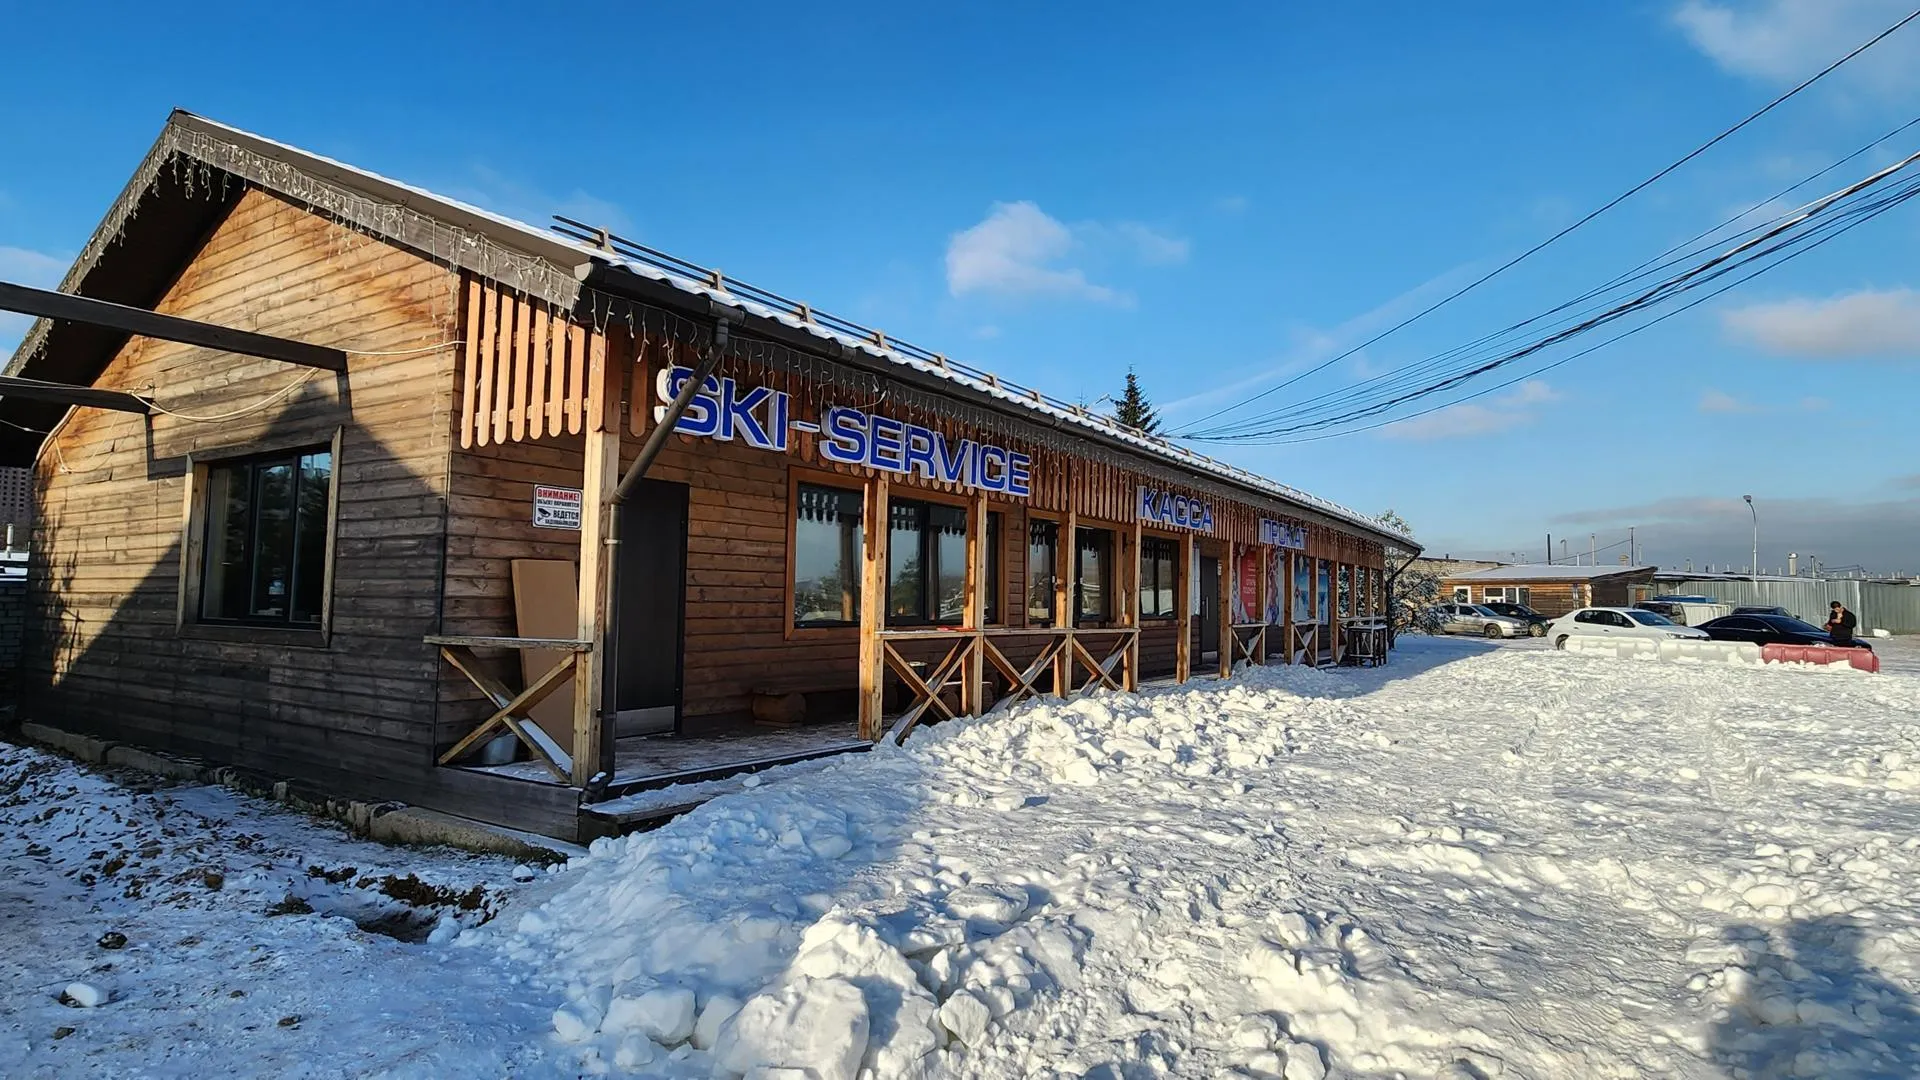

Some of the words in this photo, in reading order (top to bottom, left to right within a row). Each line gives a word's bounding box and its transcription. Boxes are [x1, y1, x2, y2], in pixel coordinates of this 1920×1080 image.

[657, 366, 1030, 497] SKI-SERVICE
[538, 489, 579, 501] ВНИМАНИЕ!
[1139, 486, 1214, 532] КАССА
[1262, 518, 1308, 550] ПРОКАТ
